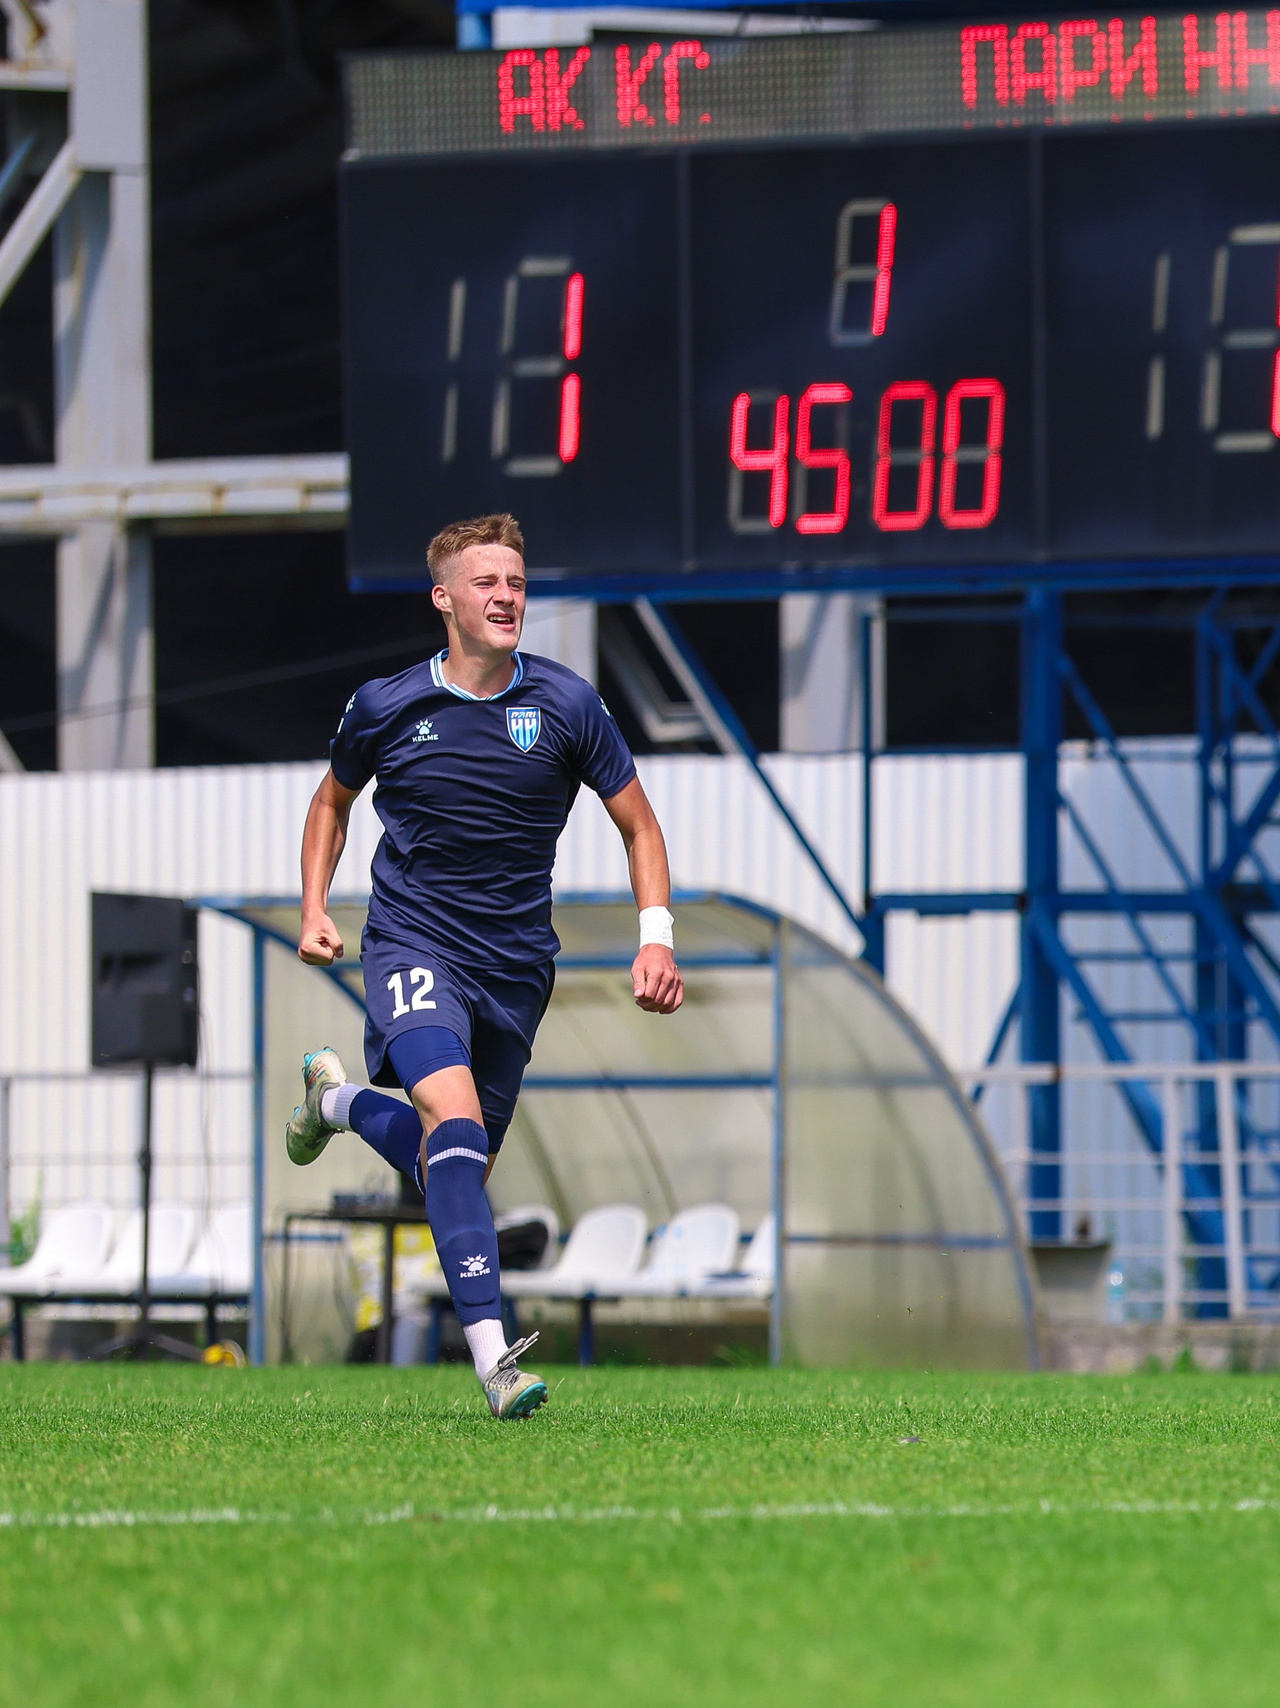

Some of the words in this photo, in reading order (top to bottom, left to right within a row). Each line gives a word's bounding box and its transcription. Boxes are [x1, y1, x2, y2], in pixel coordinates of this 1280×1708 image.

[498, 46, 591, 133] АК
[960, 16, 1159, 115] ПАРИ
[412, 733, 439, 742] KELME
[387, 967, 437, 1019] 12
[459, 1267, 491, 1278] KELME
